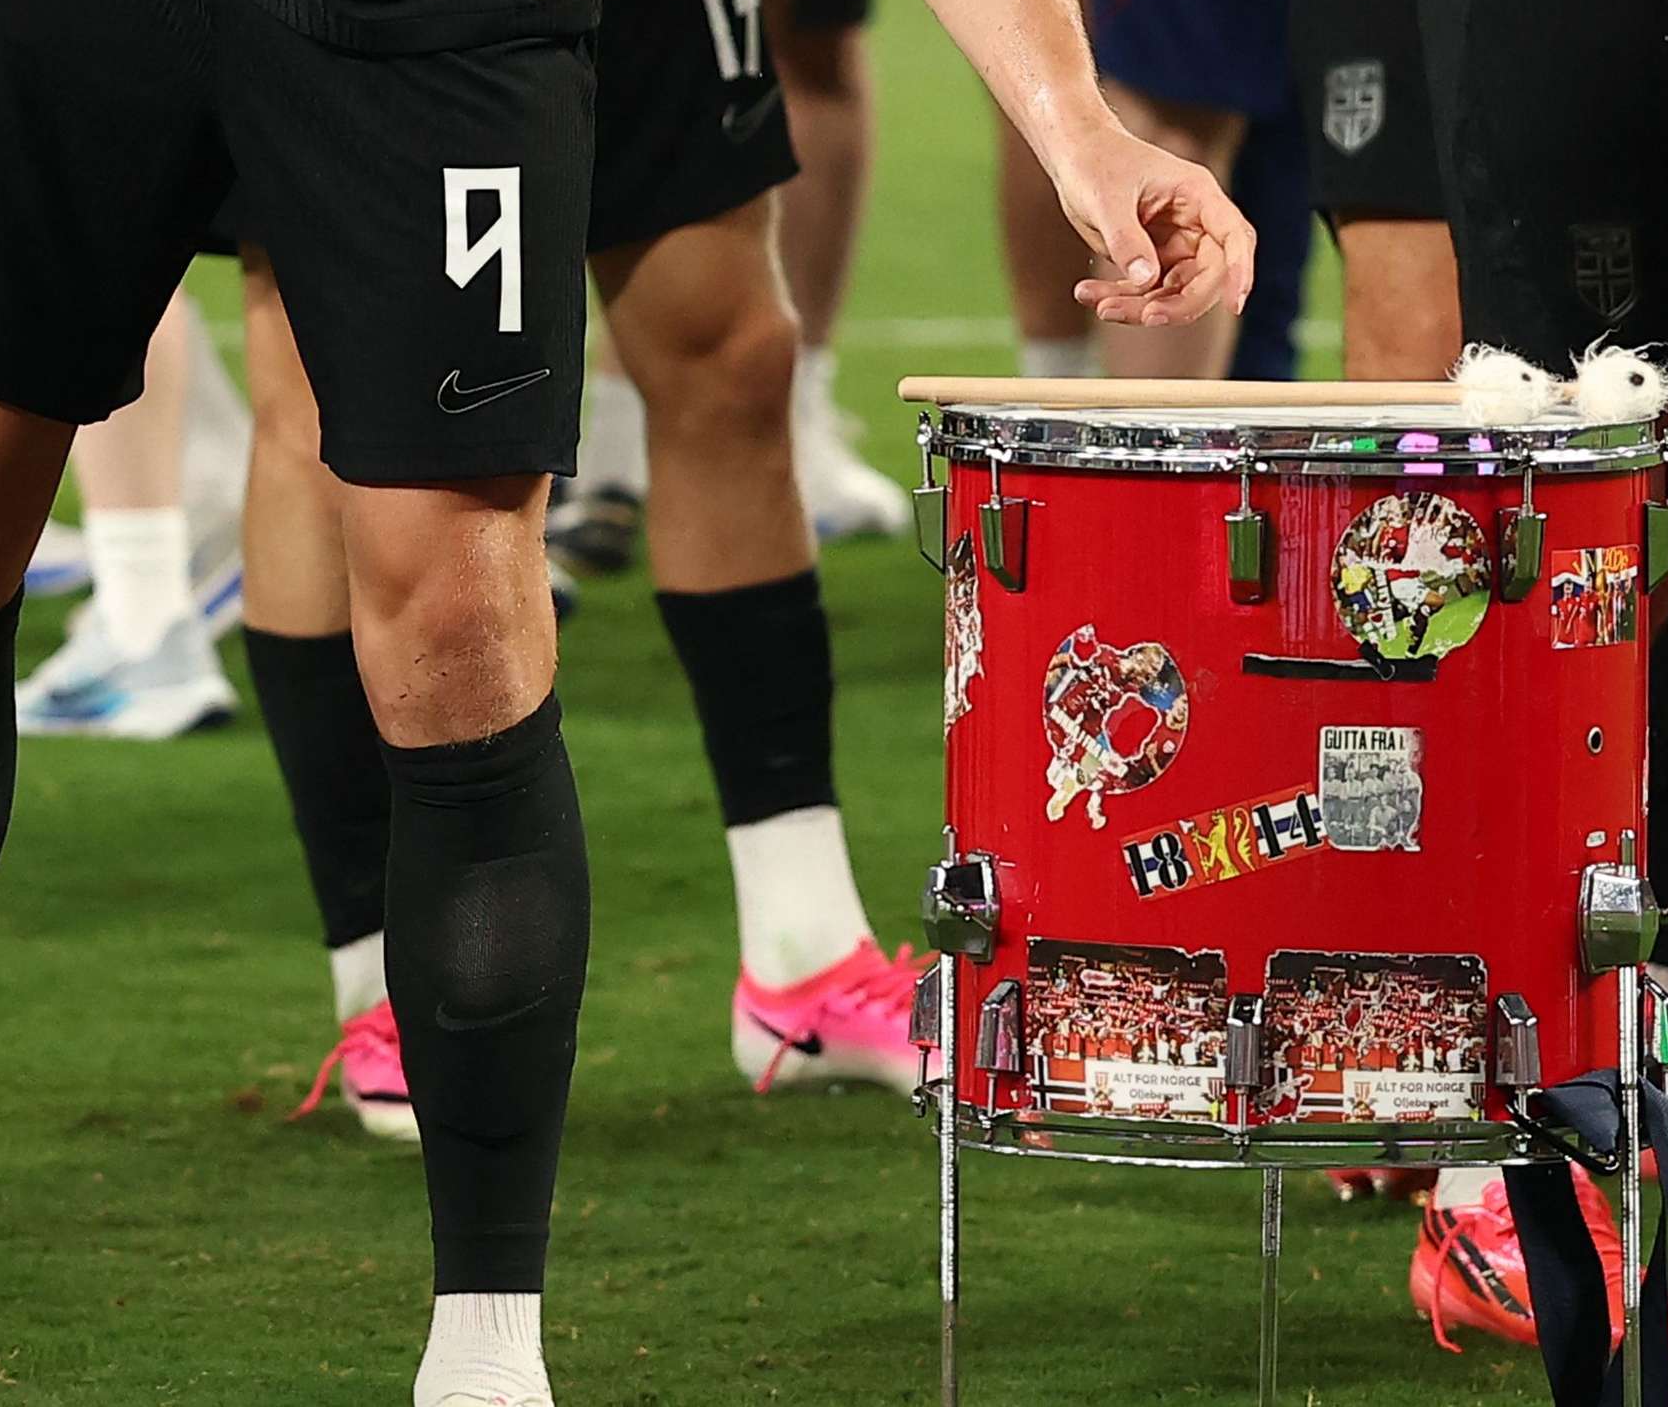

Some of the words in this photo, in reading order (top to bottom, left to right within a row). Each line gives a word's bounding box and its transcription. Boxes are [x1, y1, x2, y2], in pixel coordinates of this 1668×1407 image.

[443, 166, 522, 334] 9
[1324, 730, 1367, 750] GUTTA
[1371, 730, 1395, 750] FRA
[1122, 831, 1189, 897] 18
[1252, 791, 1323, 859] 14
[1113, 1073, 1132, 1083] ALT
[1135, 1073, 1159, 1086] FOR
[1160, 1075, 1202, 1087] NORGE
[1375, 1082, 1398, 1093] ALT
[1400, 1082, 1423, 1093] FOR
[1425, 1082, 1465, 1093] NORGE
